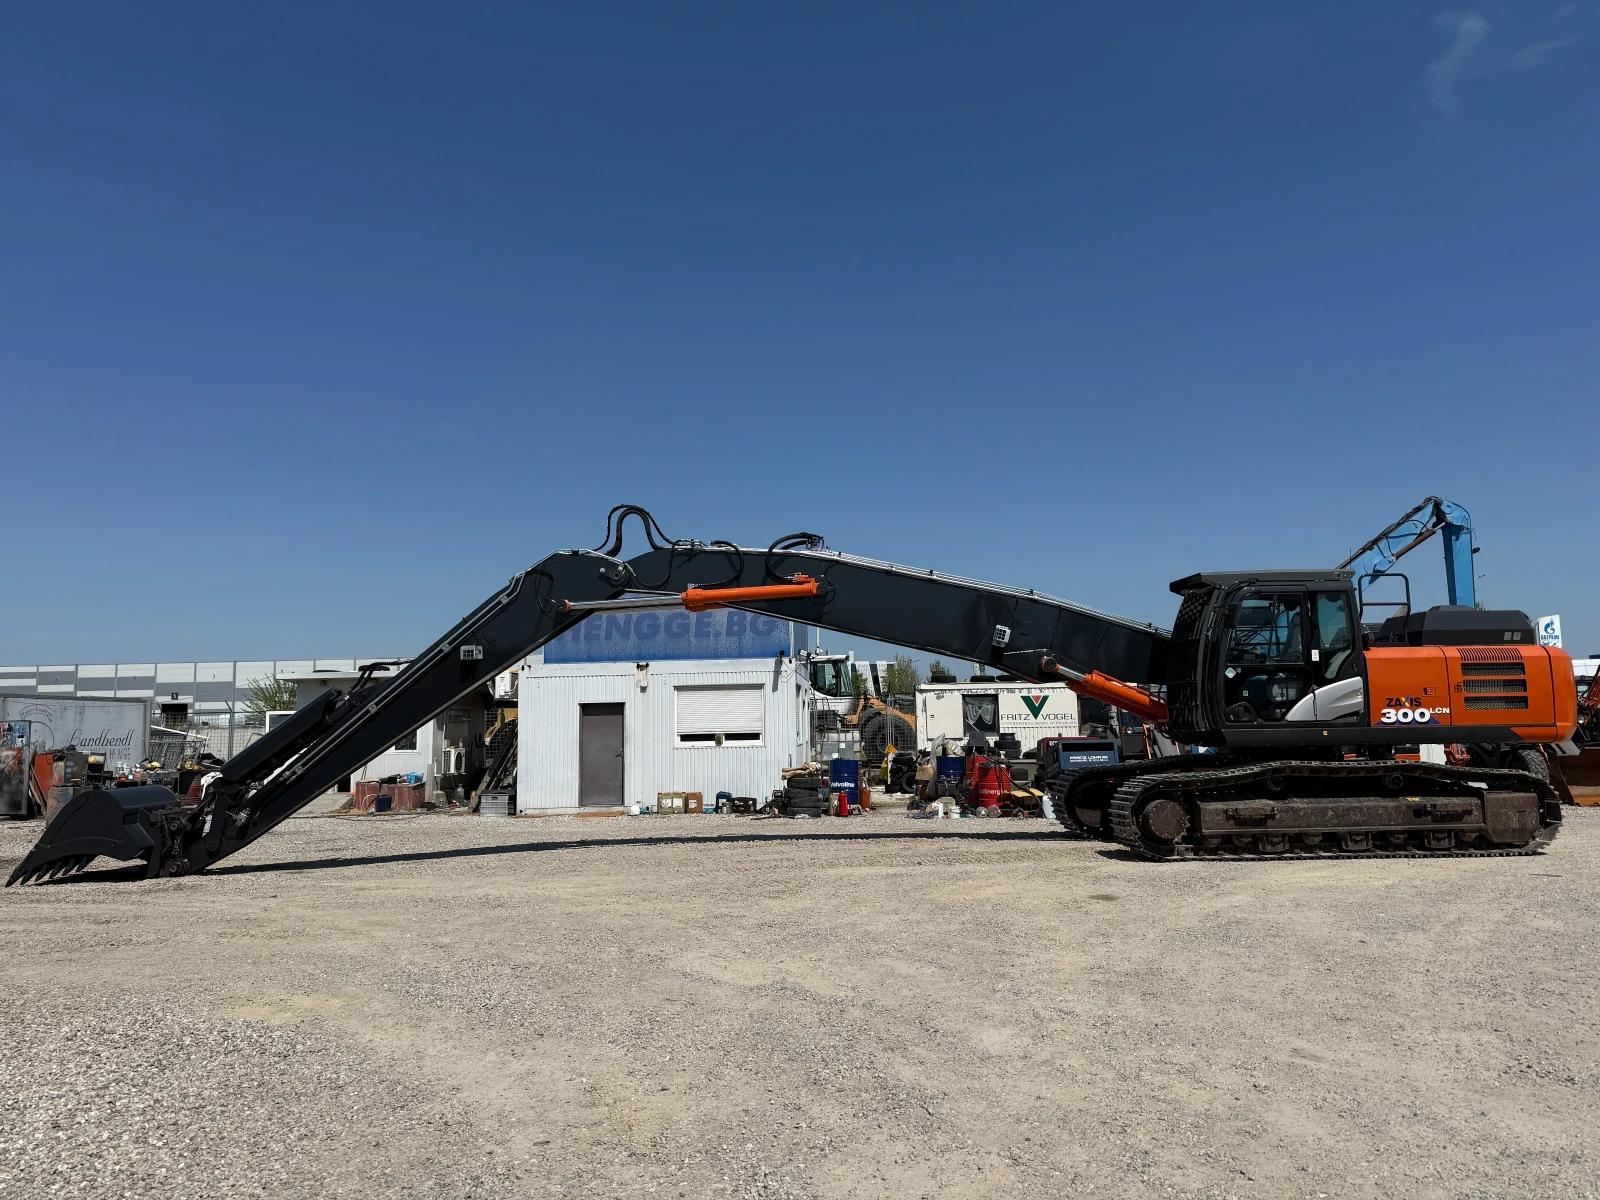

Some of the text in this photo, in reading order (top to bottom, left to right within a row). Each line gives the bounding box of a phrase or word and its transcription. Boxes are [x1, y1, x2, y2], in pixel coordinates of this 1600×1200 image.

[1386, 695, 1422, 708] ZAXIS
[1380, 708, 1431, 724] 300
[70, 729, 135, 746] Landhendl
